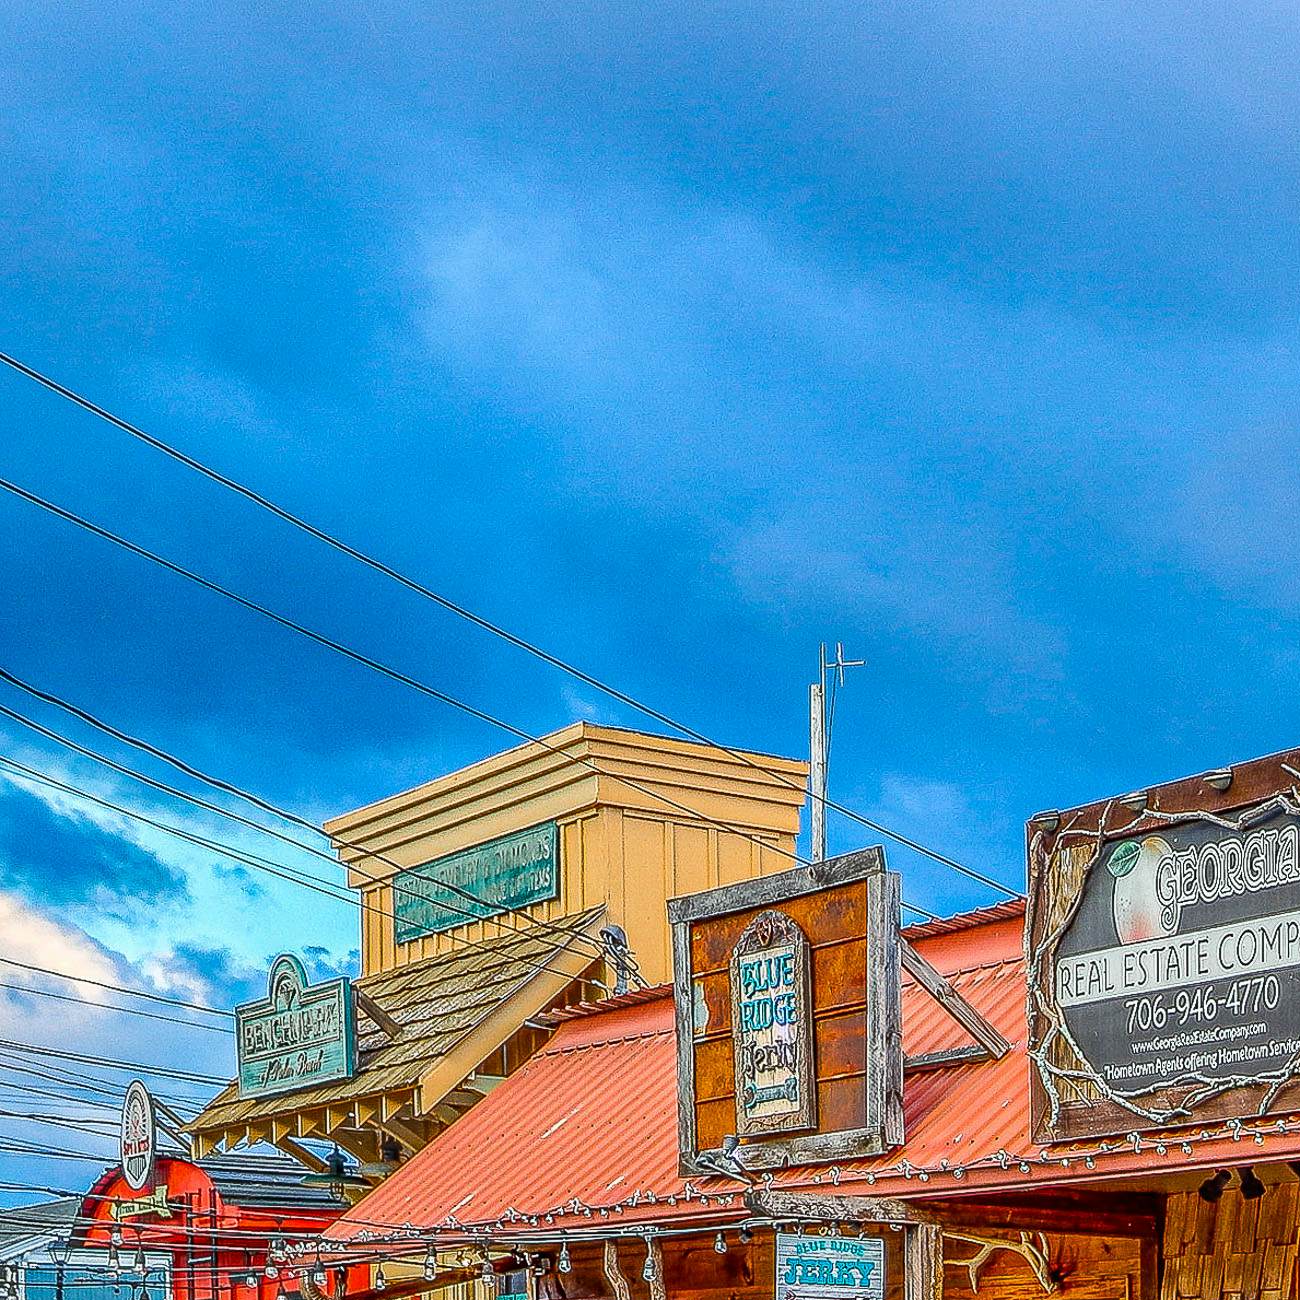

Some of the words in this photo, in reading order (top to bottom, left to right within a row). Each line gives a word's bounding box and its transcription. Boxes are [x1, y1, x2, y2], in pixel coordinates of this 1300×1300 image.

[740, 952, 795, 997] BLUE
[1059, 958, 1115, 1001] REAL
[1123, 936, 1209, 988] ESTATE
[738, 992, 798, 1033] RIDGE
[1124, 974, 1280, 1034] 706-946-4770
[1155, 1055, 1184, 1077] Agents
[1184, 1050, 1218, 1071] offering
[1218, 1044, 1269, 1064] Hometown
[795, 1240, 827, 1255] BLUE
[830, 1240, 866, 1257] RIDGE
[784, 1257, 876, 1288] JERKY
